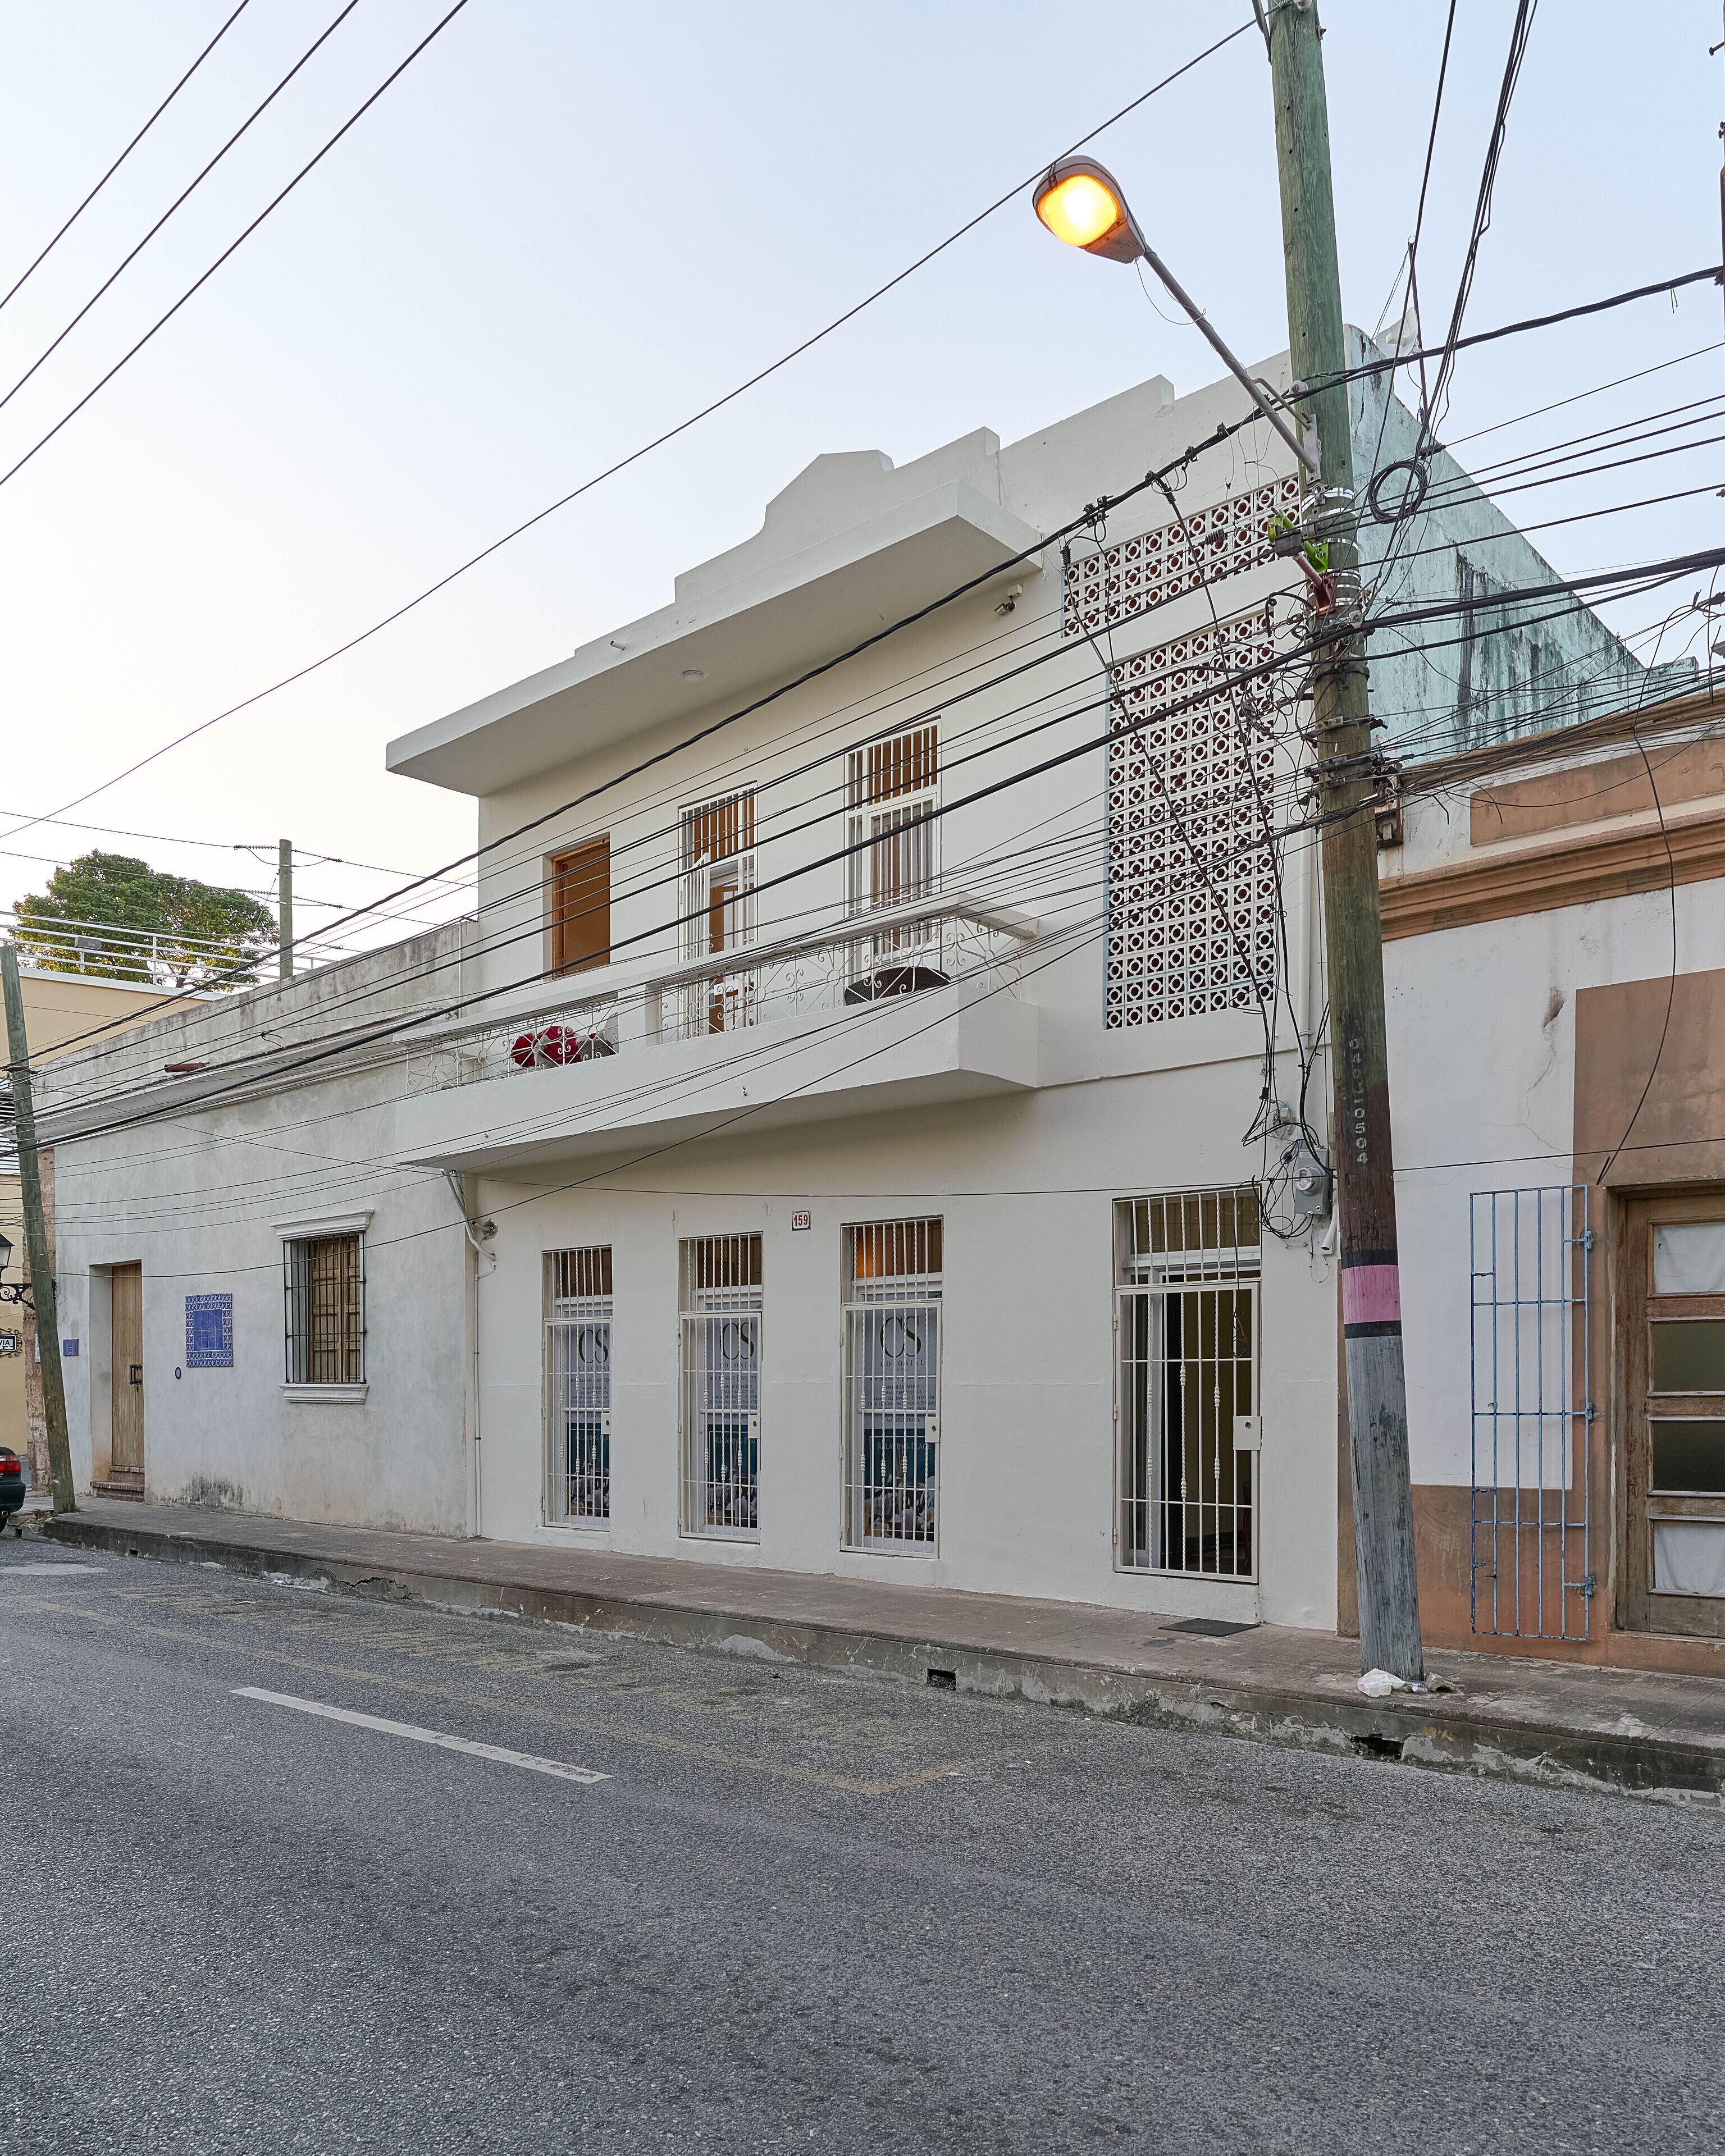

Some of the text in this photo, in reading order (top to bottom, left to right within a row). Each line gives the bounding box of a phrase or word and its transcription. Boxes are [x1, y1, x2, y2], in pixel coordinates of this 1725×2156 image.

[793, 1214, 808, 1227] 159
[578, 1329, 609, 1364] CS
[719, 1322, 754, 1360] CS
[880, 1314, 921, 1358] CS
[880, 1359, 924, 1368] COONIL
